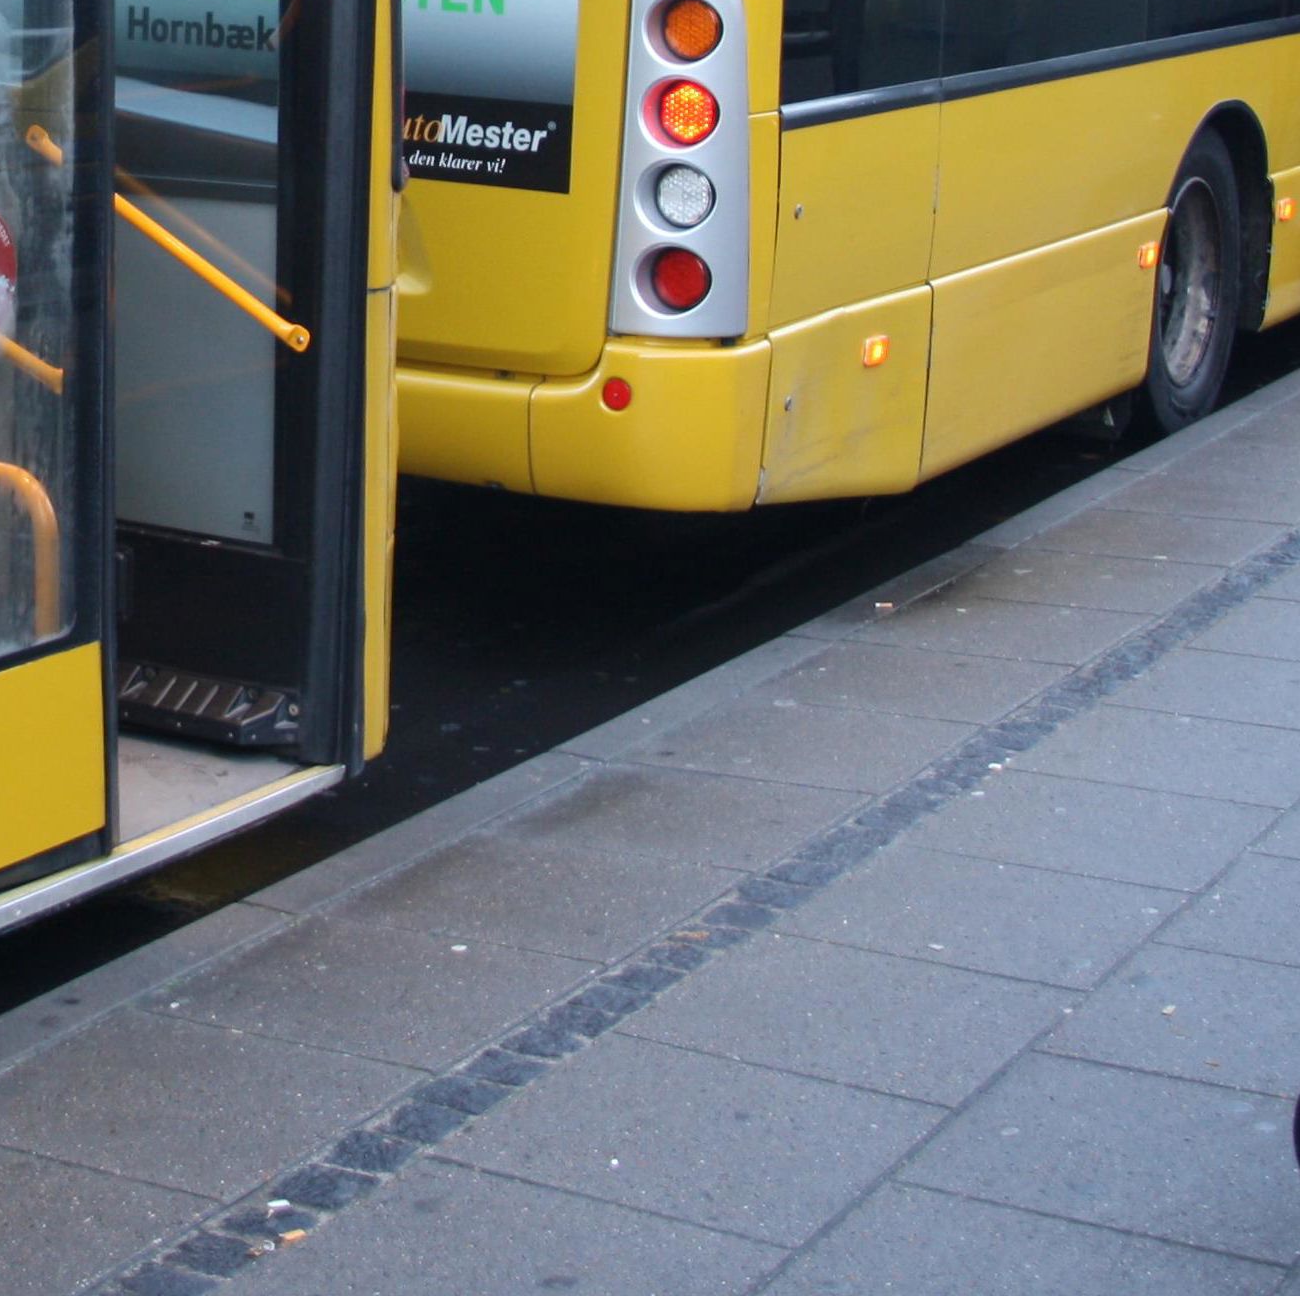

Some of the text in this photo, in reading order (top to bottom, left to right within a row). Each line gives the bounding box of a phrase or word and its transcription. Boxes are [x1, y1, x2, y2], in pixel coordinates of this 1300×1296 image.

[126, 5, 276, 53] Hornbæk
[408, 149, 507, 174] den klarer vi!
